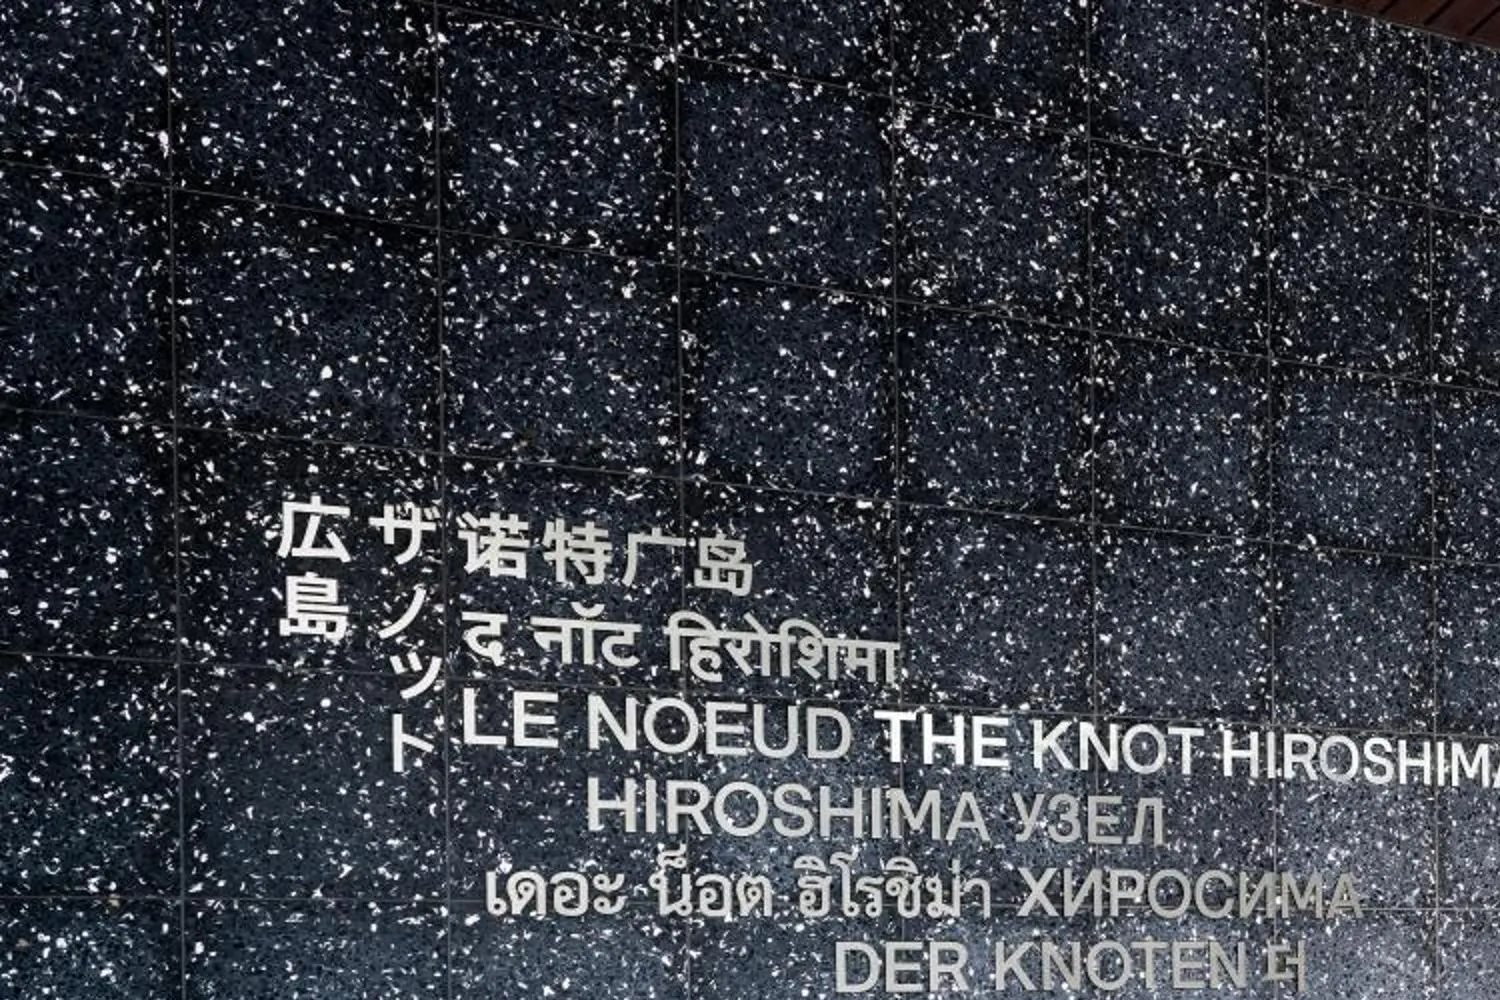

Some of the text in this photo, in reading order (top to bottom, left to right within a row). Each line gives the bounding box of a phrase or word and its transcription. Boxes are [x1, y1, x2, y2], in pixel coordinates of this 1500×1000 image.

[277, 495, 350, 641] 広島
[455, 511, 753, 597] 诺特广岛
[462, 601, 900, 684] द नॉट हिरोशिमा
[462, 688, 559, 750] LE
[588, 694, 852, 760] NOEUD
[875, 710, 1009, 769] THE
[1032, 718, 1204, 776] KNOT
[587, 777, 991, 842] HIROSHIMA
[1013, 792, 1166, 847] УЗЕЛ
[486, 870, 629, 917] เดอะ
[1018, 867, 1364, 920] ХИРОСИМА
[836, 940, 1249, 993] DER KNOTEN
